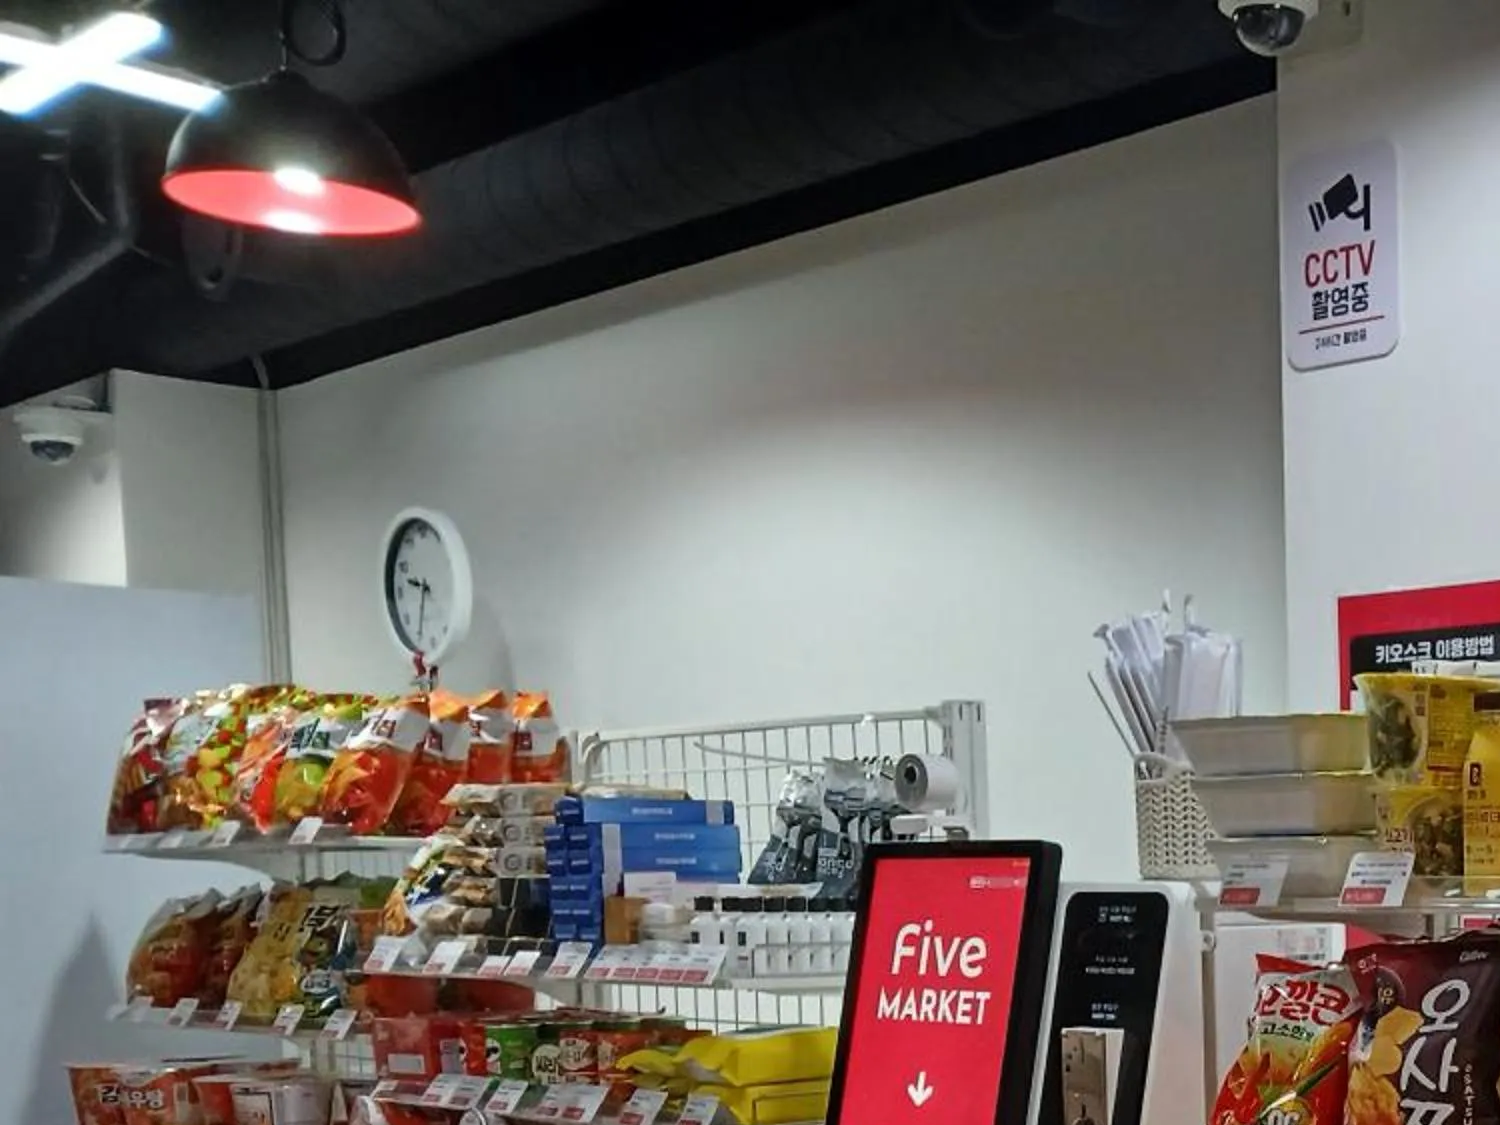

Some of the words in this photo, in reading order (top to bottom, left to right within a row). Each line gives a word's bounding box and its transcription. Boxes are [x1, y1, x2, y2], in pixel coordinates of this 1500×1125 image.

[1304, 240, 1375, 288] CCTV
[1375, 642, 1433, 664] 키오스크
[1435, 635, 1495, 659] 이용방법
[891, 919, 988, 976] Five
[876, 987, 992, 1026] MARKET
